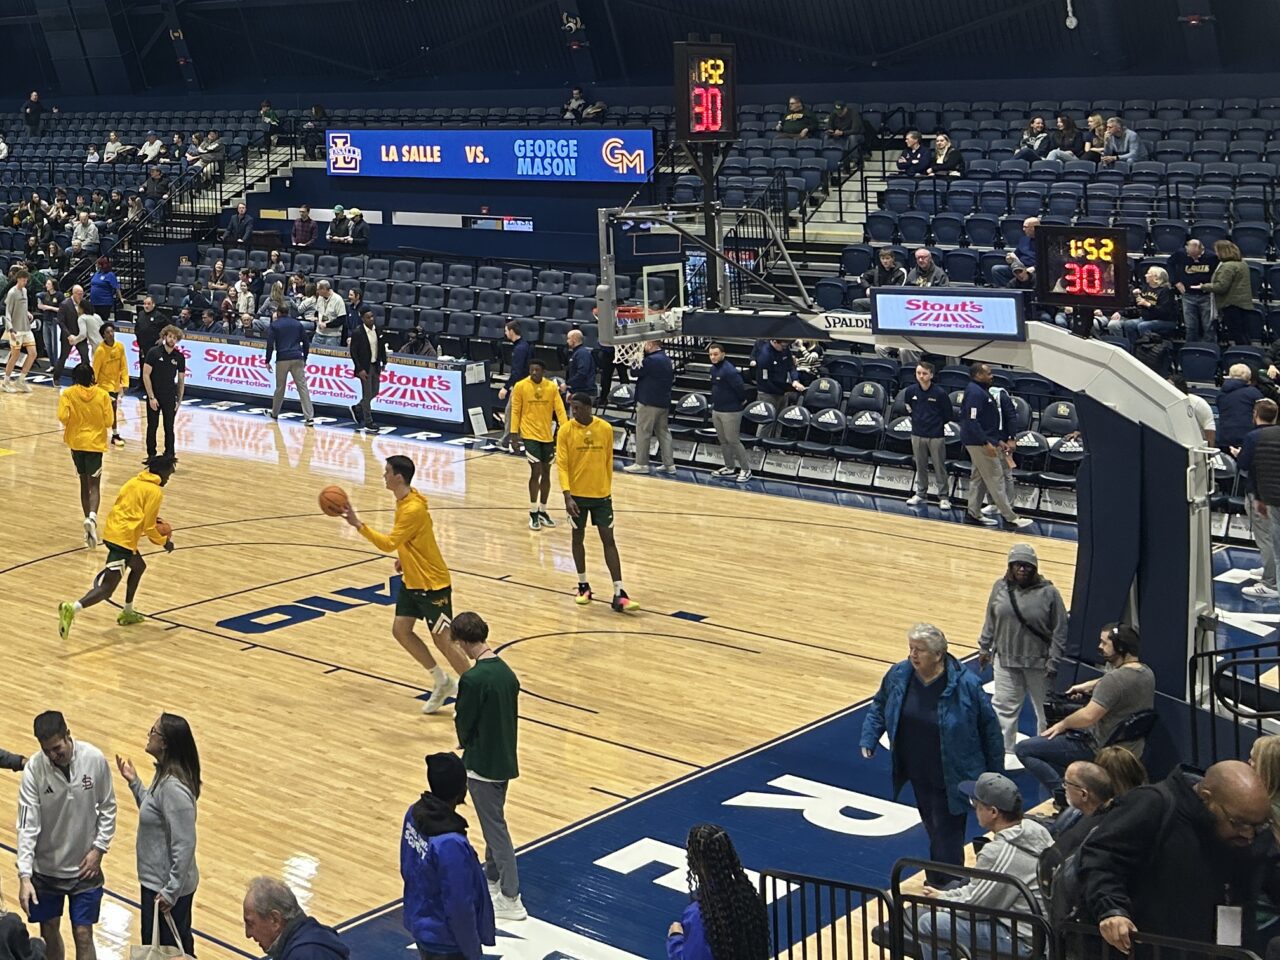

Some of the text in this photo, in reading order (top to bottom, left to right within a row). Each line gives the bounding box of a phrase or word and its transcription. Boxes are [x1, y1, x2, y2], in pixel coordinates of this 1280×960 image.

[692, 87, 722, 131] 30
[381, 145, 442, 163] LA SALLE
[465, 145, 490, 164] VS.
[514, 139, 579, 158] GEORGE
[517, 158, 576, 176] MASON
[1070, 238, 1114, 261] 1:52
[1065, 263, 1102, 294] 30
[904, 298, 983, 314] Stout's
[909, 320, 985, 330] Transportation
[204, 349, 267, 369] Stout's
[306, 364, 356, 380] out's
[380, 369, 451, 391] Stout's
[207, 375, 271, 388] Transportation
[287, 384, 357, 400] Trsportation
[376, 397, 453, 413] Transportation
